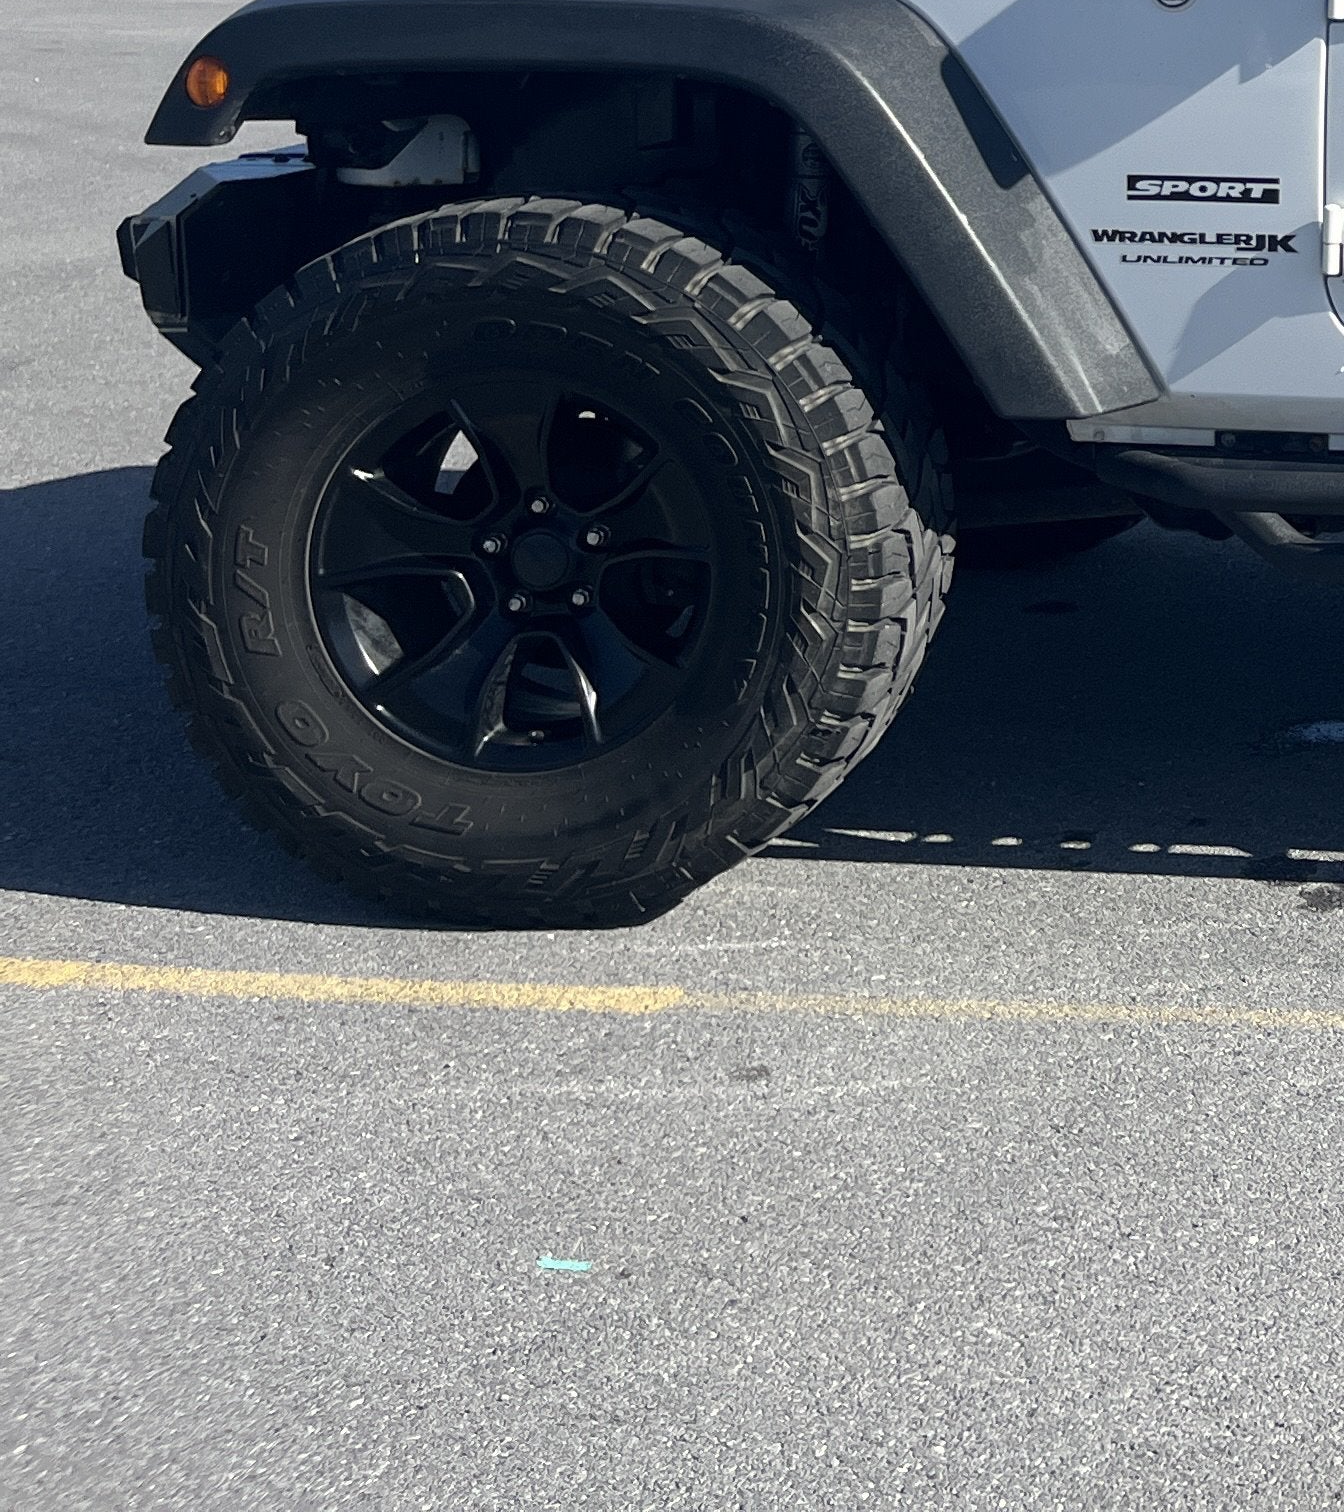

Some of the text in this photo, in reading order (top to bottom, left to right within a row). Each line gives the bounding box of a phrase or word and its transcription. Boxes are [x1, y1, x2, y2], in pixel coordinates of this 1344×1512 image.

[1134, 180, 1271, 198] SPORT
[1092, 229, 1253, 246] WRANGLER
[1121, 254, 1269, 266] UNLIMITED
[235, 524, 282, 659] R/T
[275, 699, 475, 838] TOYO
